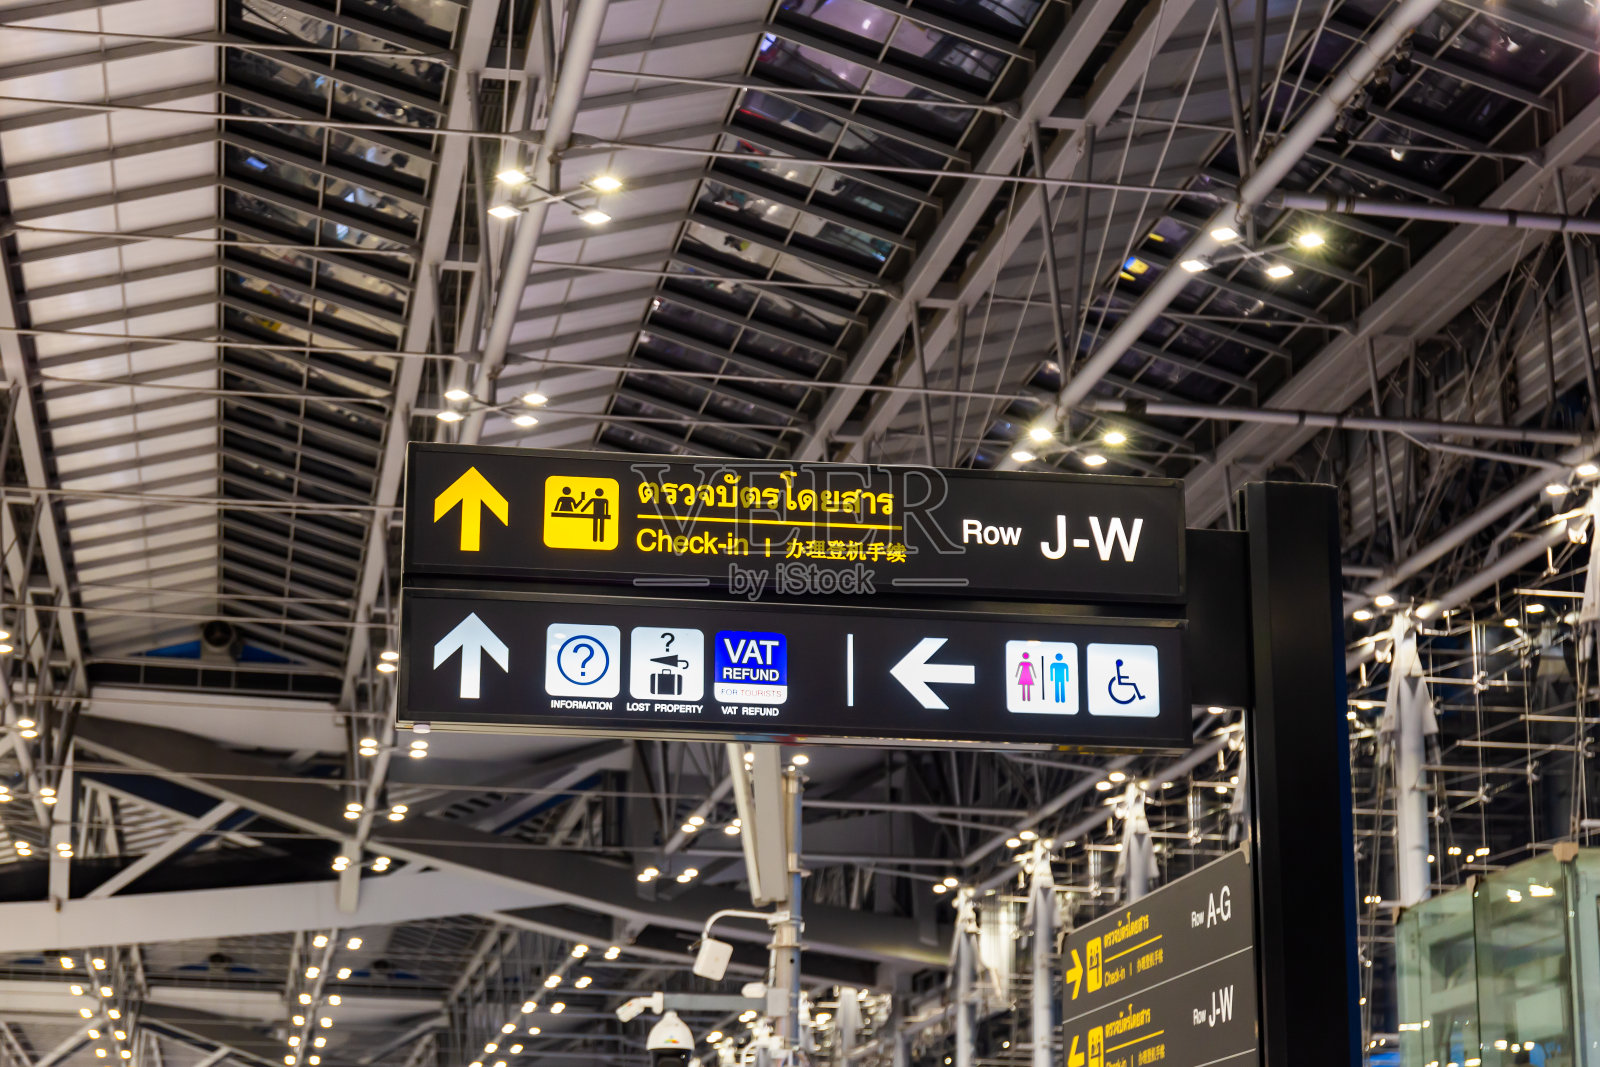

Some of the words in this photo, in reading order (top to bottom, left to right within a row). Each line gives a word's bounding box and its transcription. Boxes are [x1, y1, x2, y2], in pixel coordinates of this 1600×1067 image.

[637, 471, 895, 515] ตรวจบัตรโดยสาร
[636, 529, 749, 556] Check-in
[962, 519, 1022, 545] Row
[1040, 514, 1143, 562] J-W
[786, 540, 907, 563] 办理登机手续
[724, 638, 779, 665] VAT
[722, 667, 780, 682] REFUND
[550, 700, 613, 711] INFORMATION
[720, 688, 738, 696] FOR
[740, 689, 782, 698] TOURISTS
[626, 703, 650, 712] LOST
[654, 704, 703, 714] PROPERTY
[721, 706, 738, 715] VAT
[741, 706, 779, 717] REFUND
[1191, 910, 1204, 928] Row
[1207, 885, 1232, 928] A-G
[1193, 1008, 1207, 1026] Row
[1208, 985, 1234, 1027] J-W
